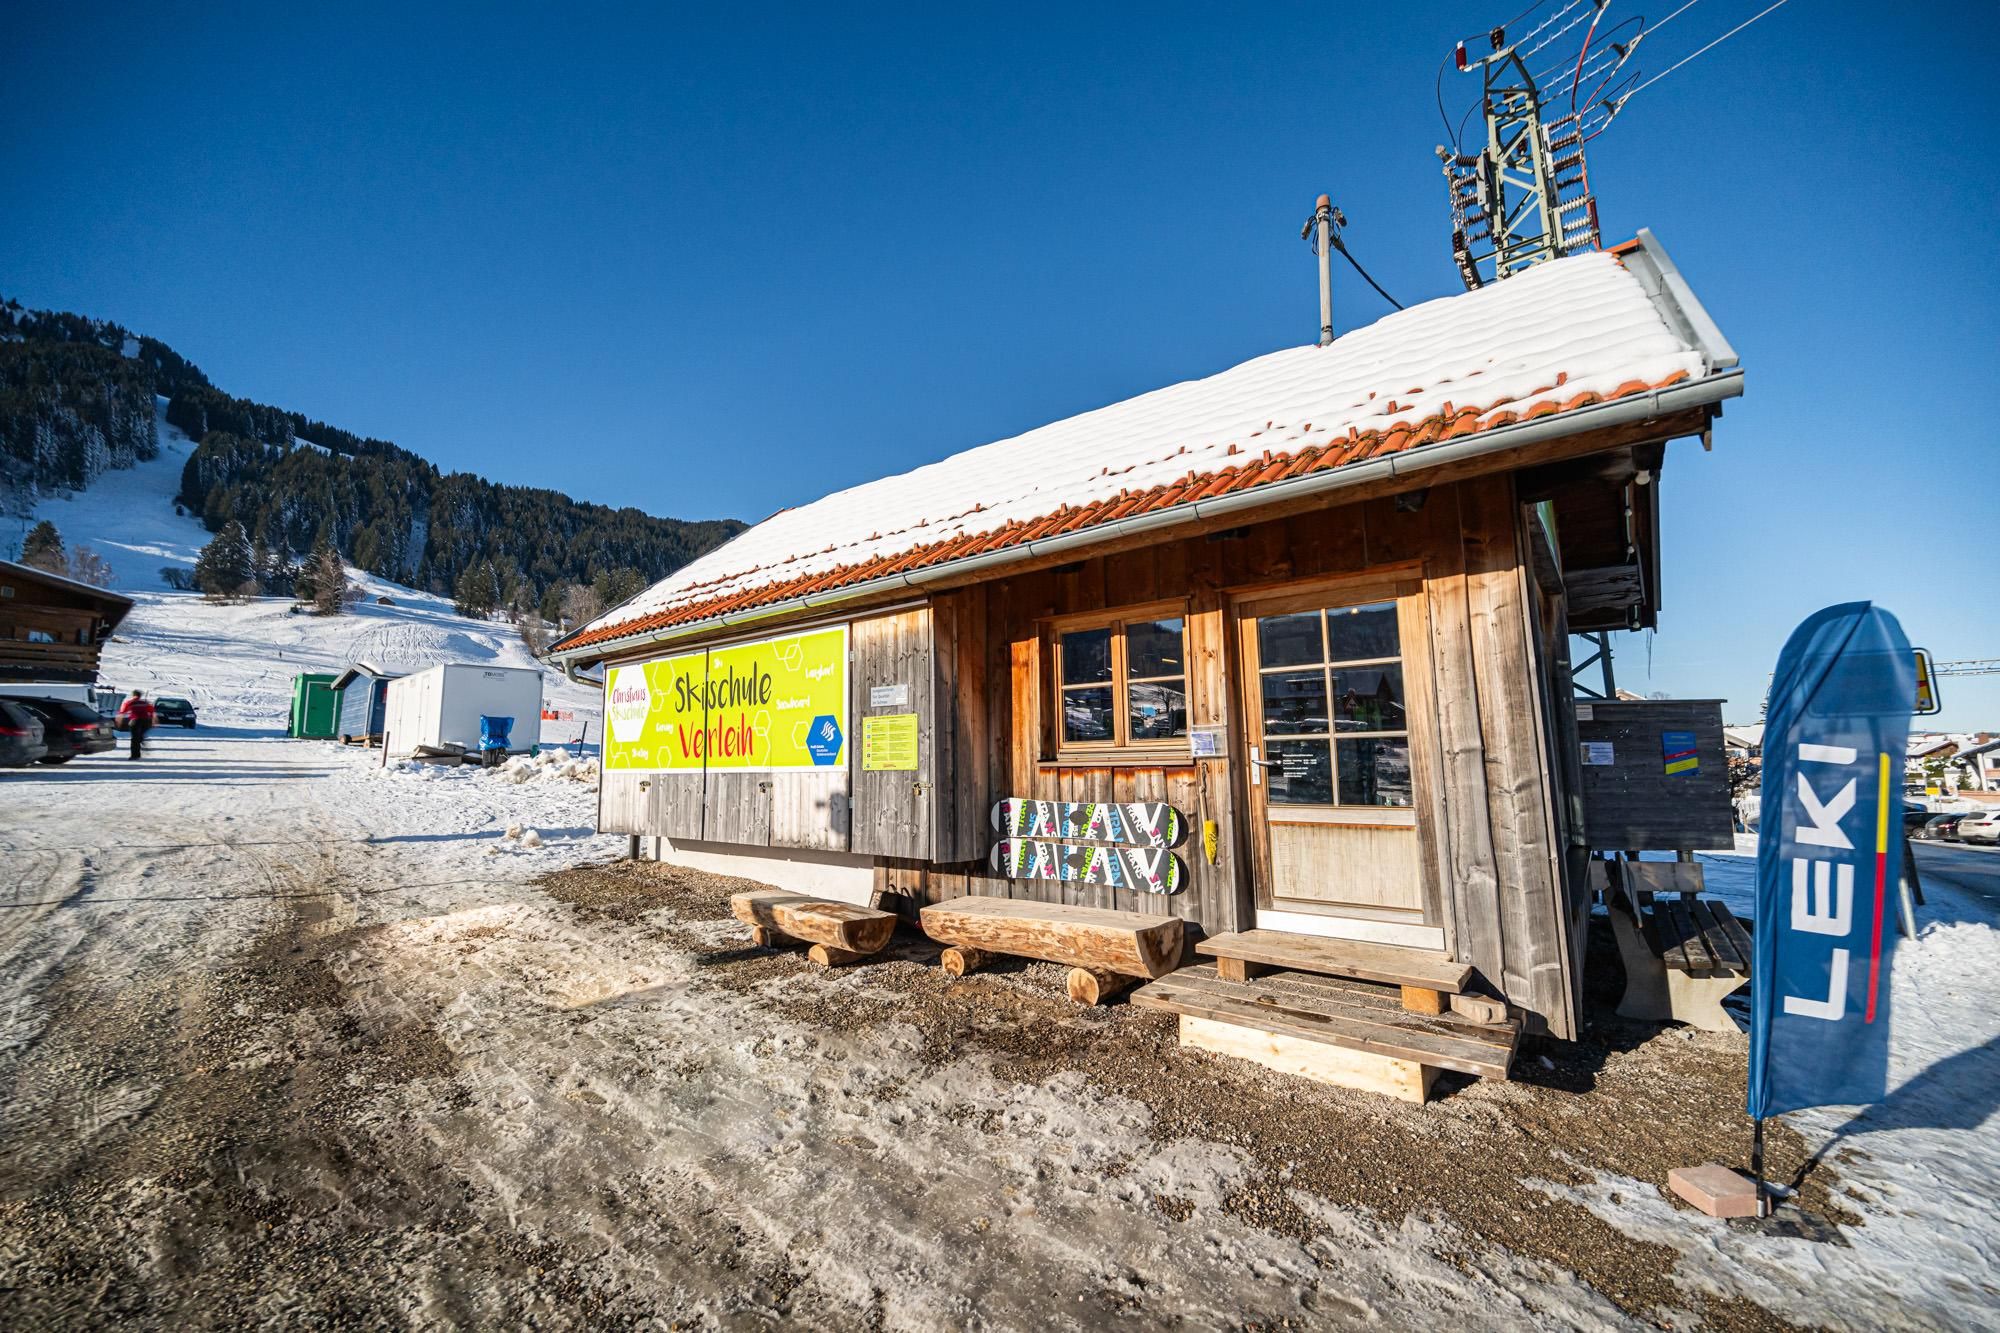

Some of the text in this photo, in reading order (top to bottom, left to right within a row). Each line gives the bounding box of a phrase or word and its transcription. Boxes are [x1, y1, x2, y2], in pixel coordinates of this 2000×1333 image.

[675, 661, 771, 713] Skischule
[679, 712, 753, 759] Verleih
[1783, 743, 1857, 1021] LEKI
